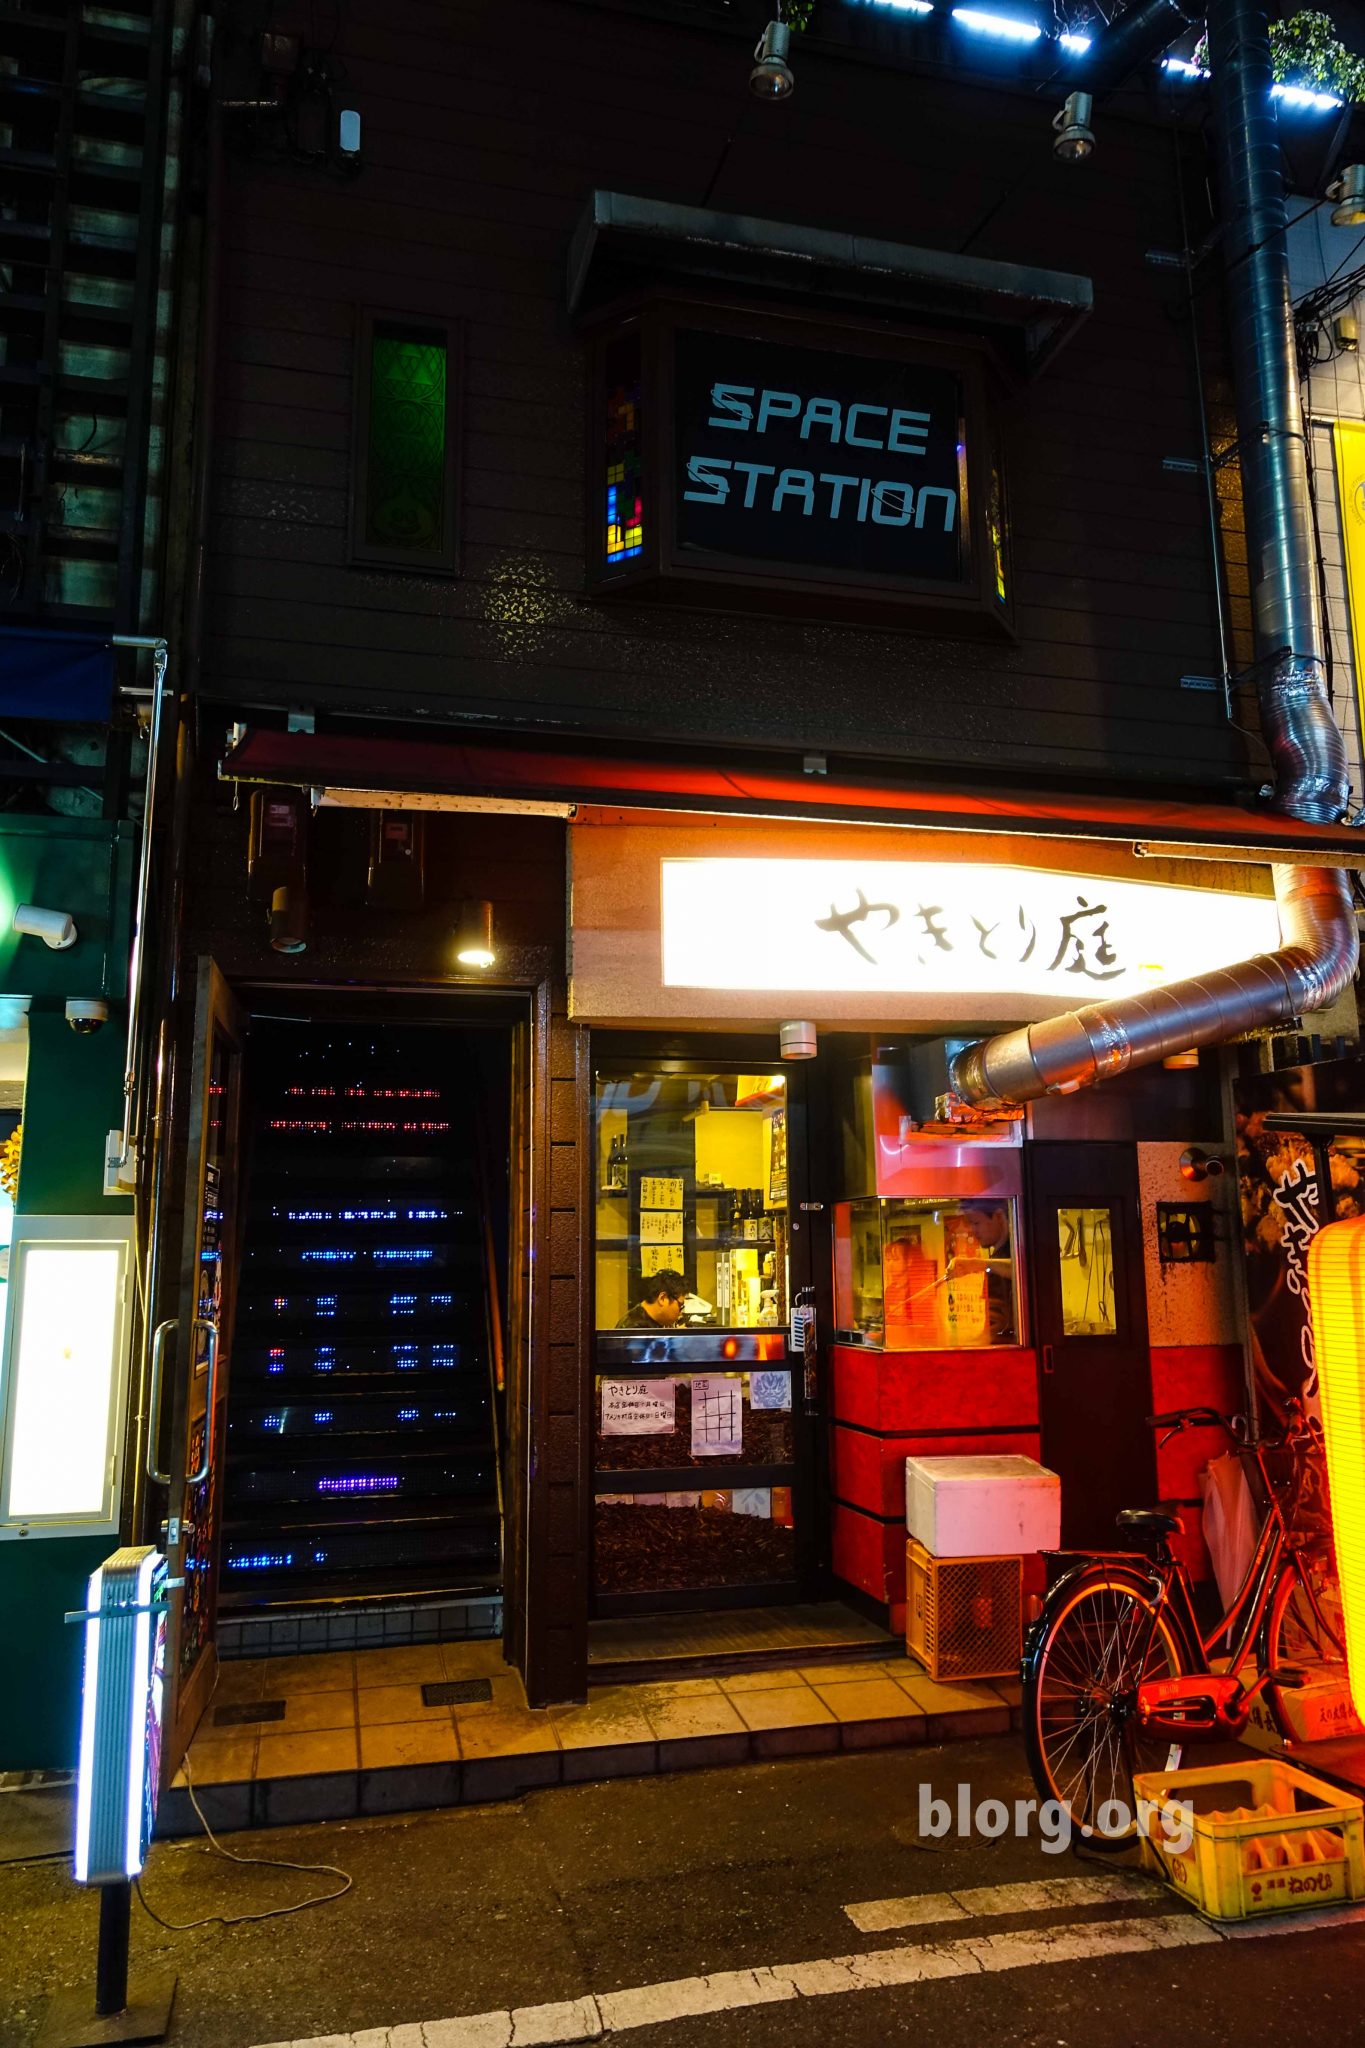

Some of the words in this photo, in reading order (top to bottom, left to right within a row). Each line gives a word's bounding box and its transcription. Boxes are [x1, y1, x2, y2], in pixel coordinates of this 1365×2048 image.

[708, 383, 931, 455] SPACE
[684, 456, 957, 531] STATION
[815, 888, 1126, 981] やきとり庭
[608, 1384, 648, 1397] やきとり庭
